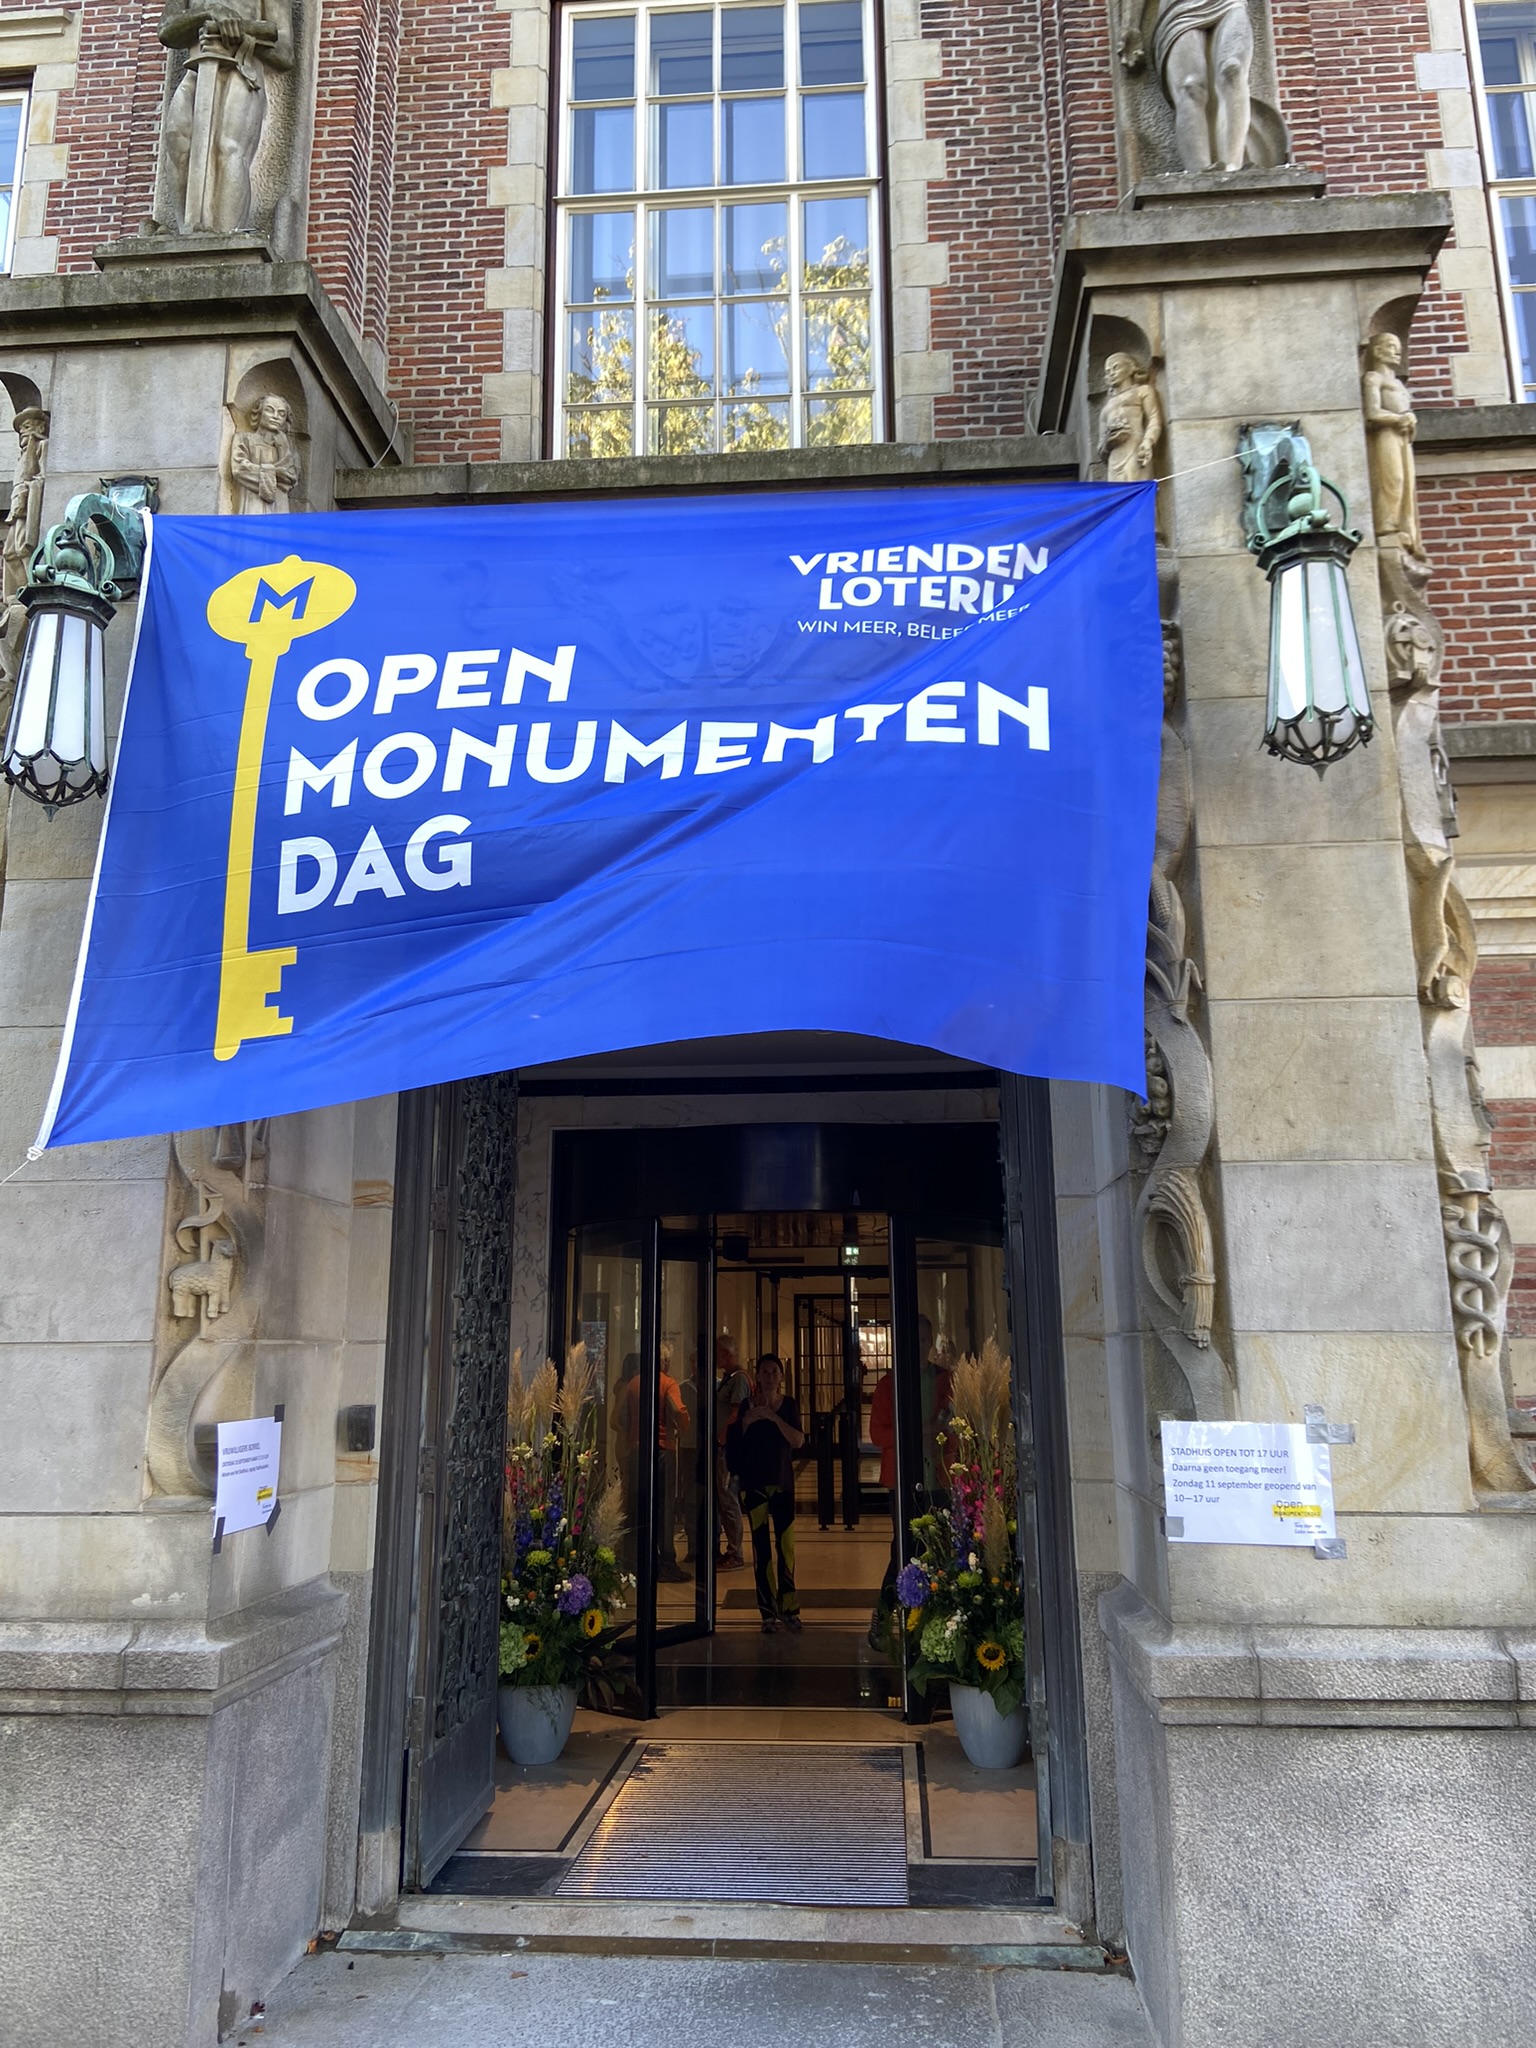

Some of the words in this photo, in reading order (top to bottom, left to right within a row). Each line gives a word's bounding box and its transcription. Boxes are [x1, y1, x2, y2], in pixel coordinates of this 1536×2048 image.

[789, 543, 1048, 580] VRIENDEN
[798, 621, 838, 633] WIN
[844, 621, 902, 637] MEER,
[297, 646, 577, 720] OPEN
[284, 682, 1050, 816] MONUMENTEN
[278, 815, 472, 914] DAG
[1171, 1447, 1212, 1457] STADHUIS
[1213, 1448, 1237, 1457] OPEN
[1239, 1449, 1255, 1457] TOT
[1257, 1449, 1268, 1458] 17
[1269, 1450, 1289, 1458] UUR
[1172, 1463, 1202, 1472] Daarna
[1203, 1465, 1225, 1474] geen
[1226, 1465, 1259, 1475] toegang
[1261, 1466, 1287, 1474] meer!
[1172, 1479, 1204, 1489] Zondag
[1205, 1480, 1216, 1488] 11
[1217, 1481, 1262, 1490] september
[1264, 1482, 1301, 1491] geopend
[1276, 1500, 1303, 1509] Open
